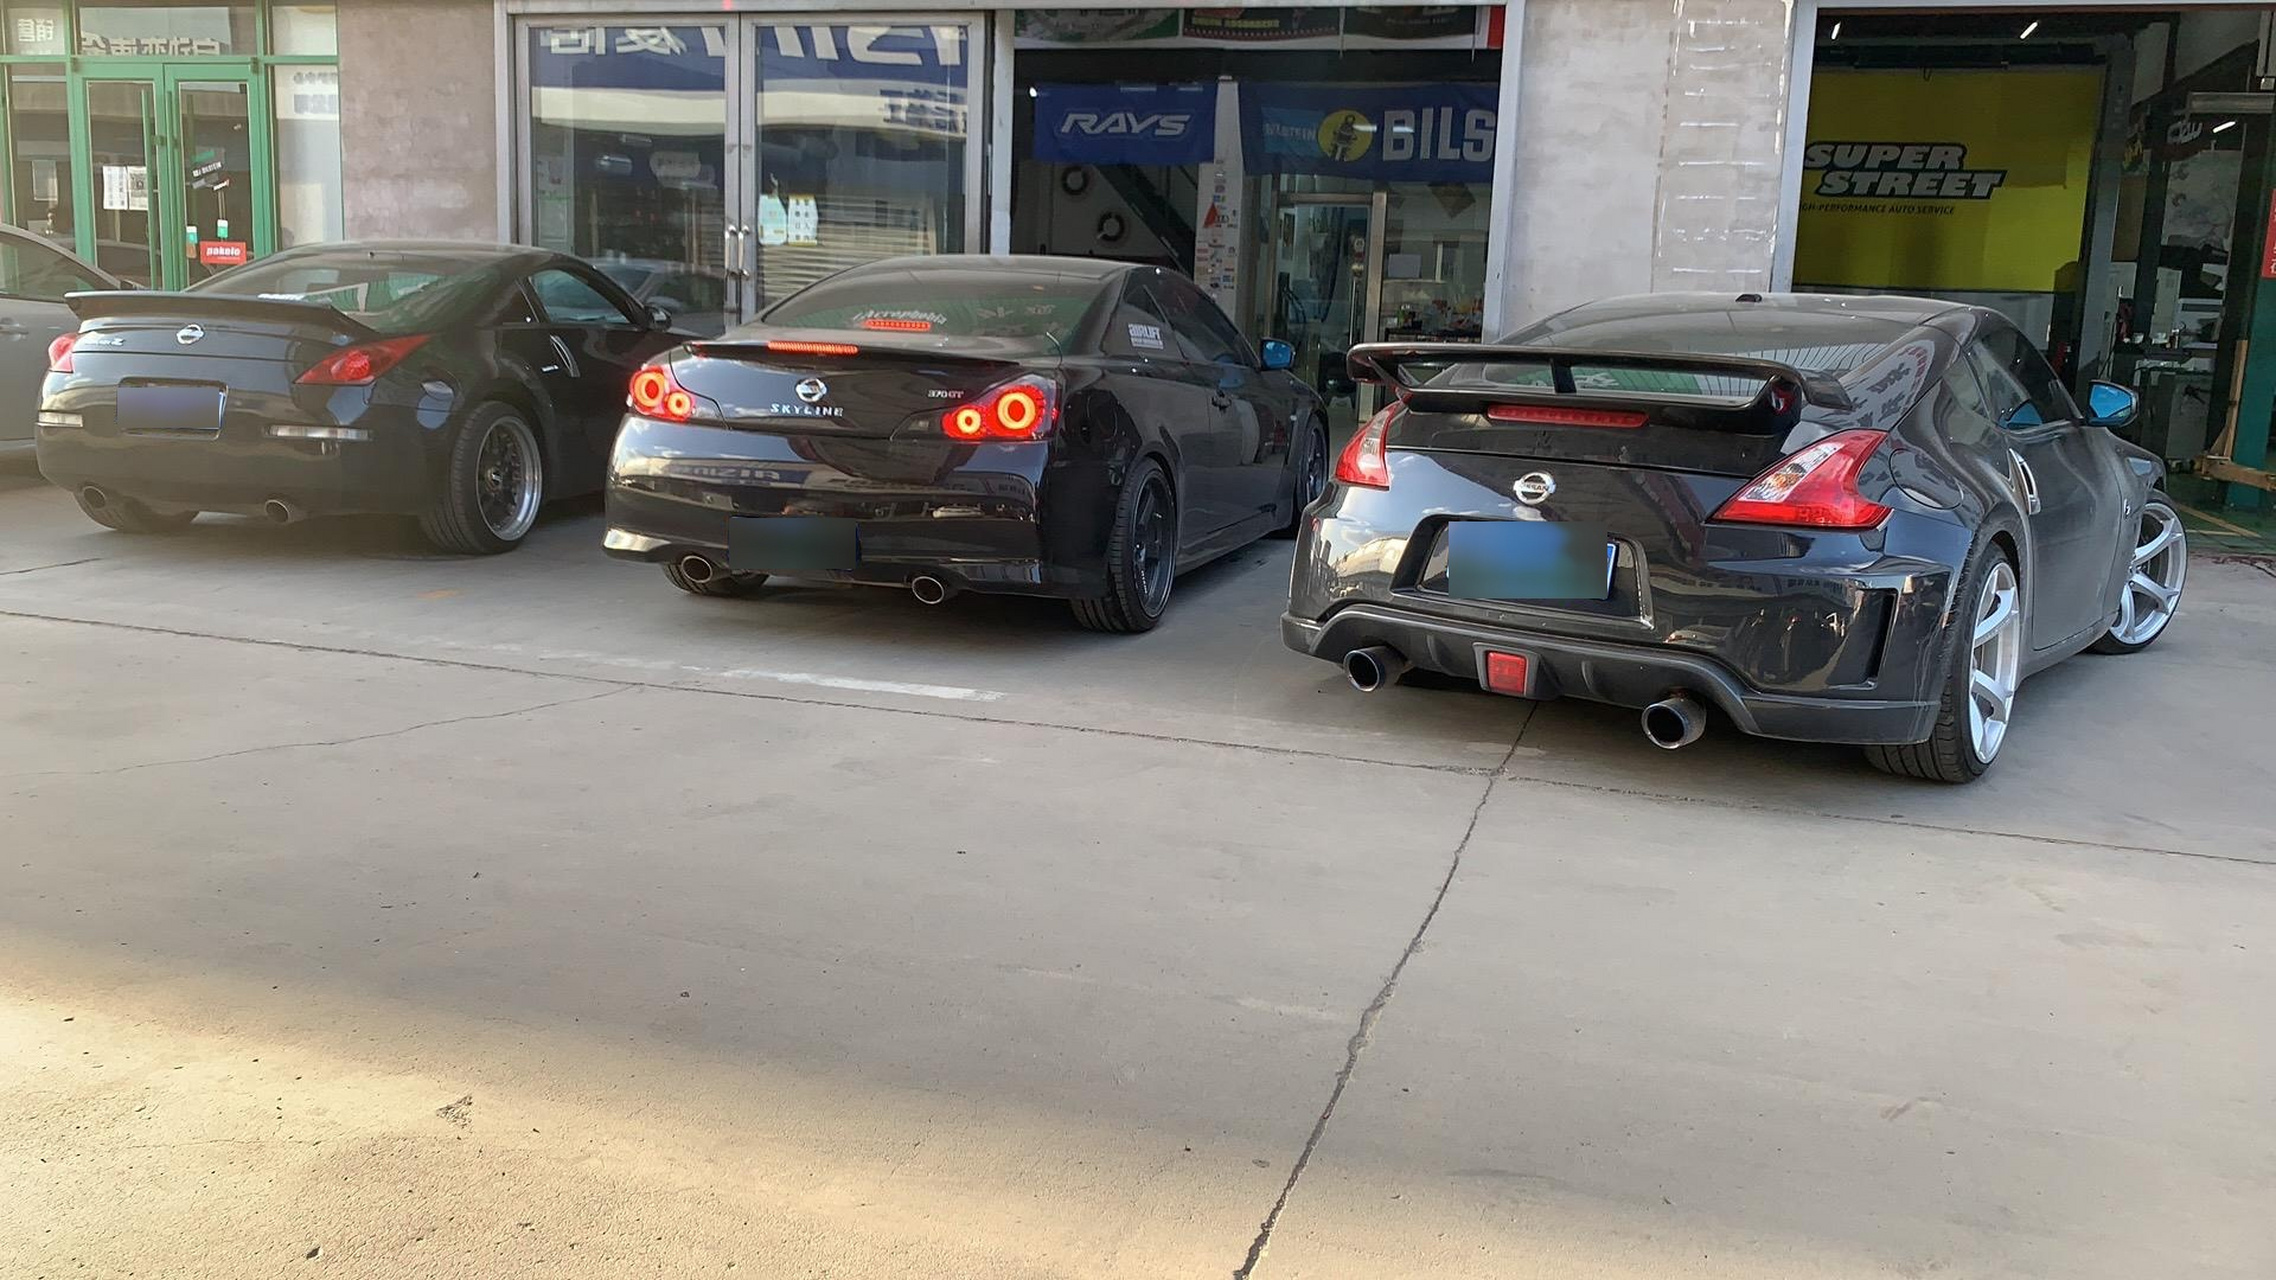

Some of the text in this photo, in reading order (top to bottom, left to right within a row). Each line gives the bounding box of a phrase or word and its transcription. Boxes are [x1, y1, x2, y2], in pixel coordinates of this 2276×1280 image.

[1061, 112, 1191, 136] RAYS
[1382, 107, 1496, 162] BILS
[1804, 144, 1965, 170] SUPER
[1818, 171, 2003, 197] STREET
[1888, 204, 1915, 214] AUTO
[770, 403, 844, 417] SKYLINE
